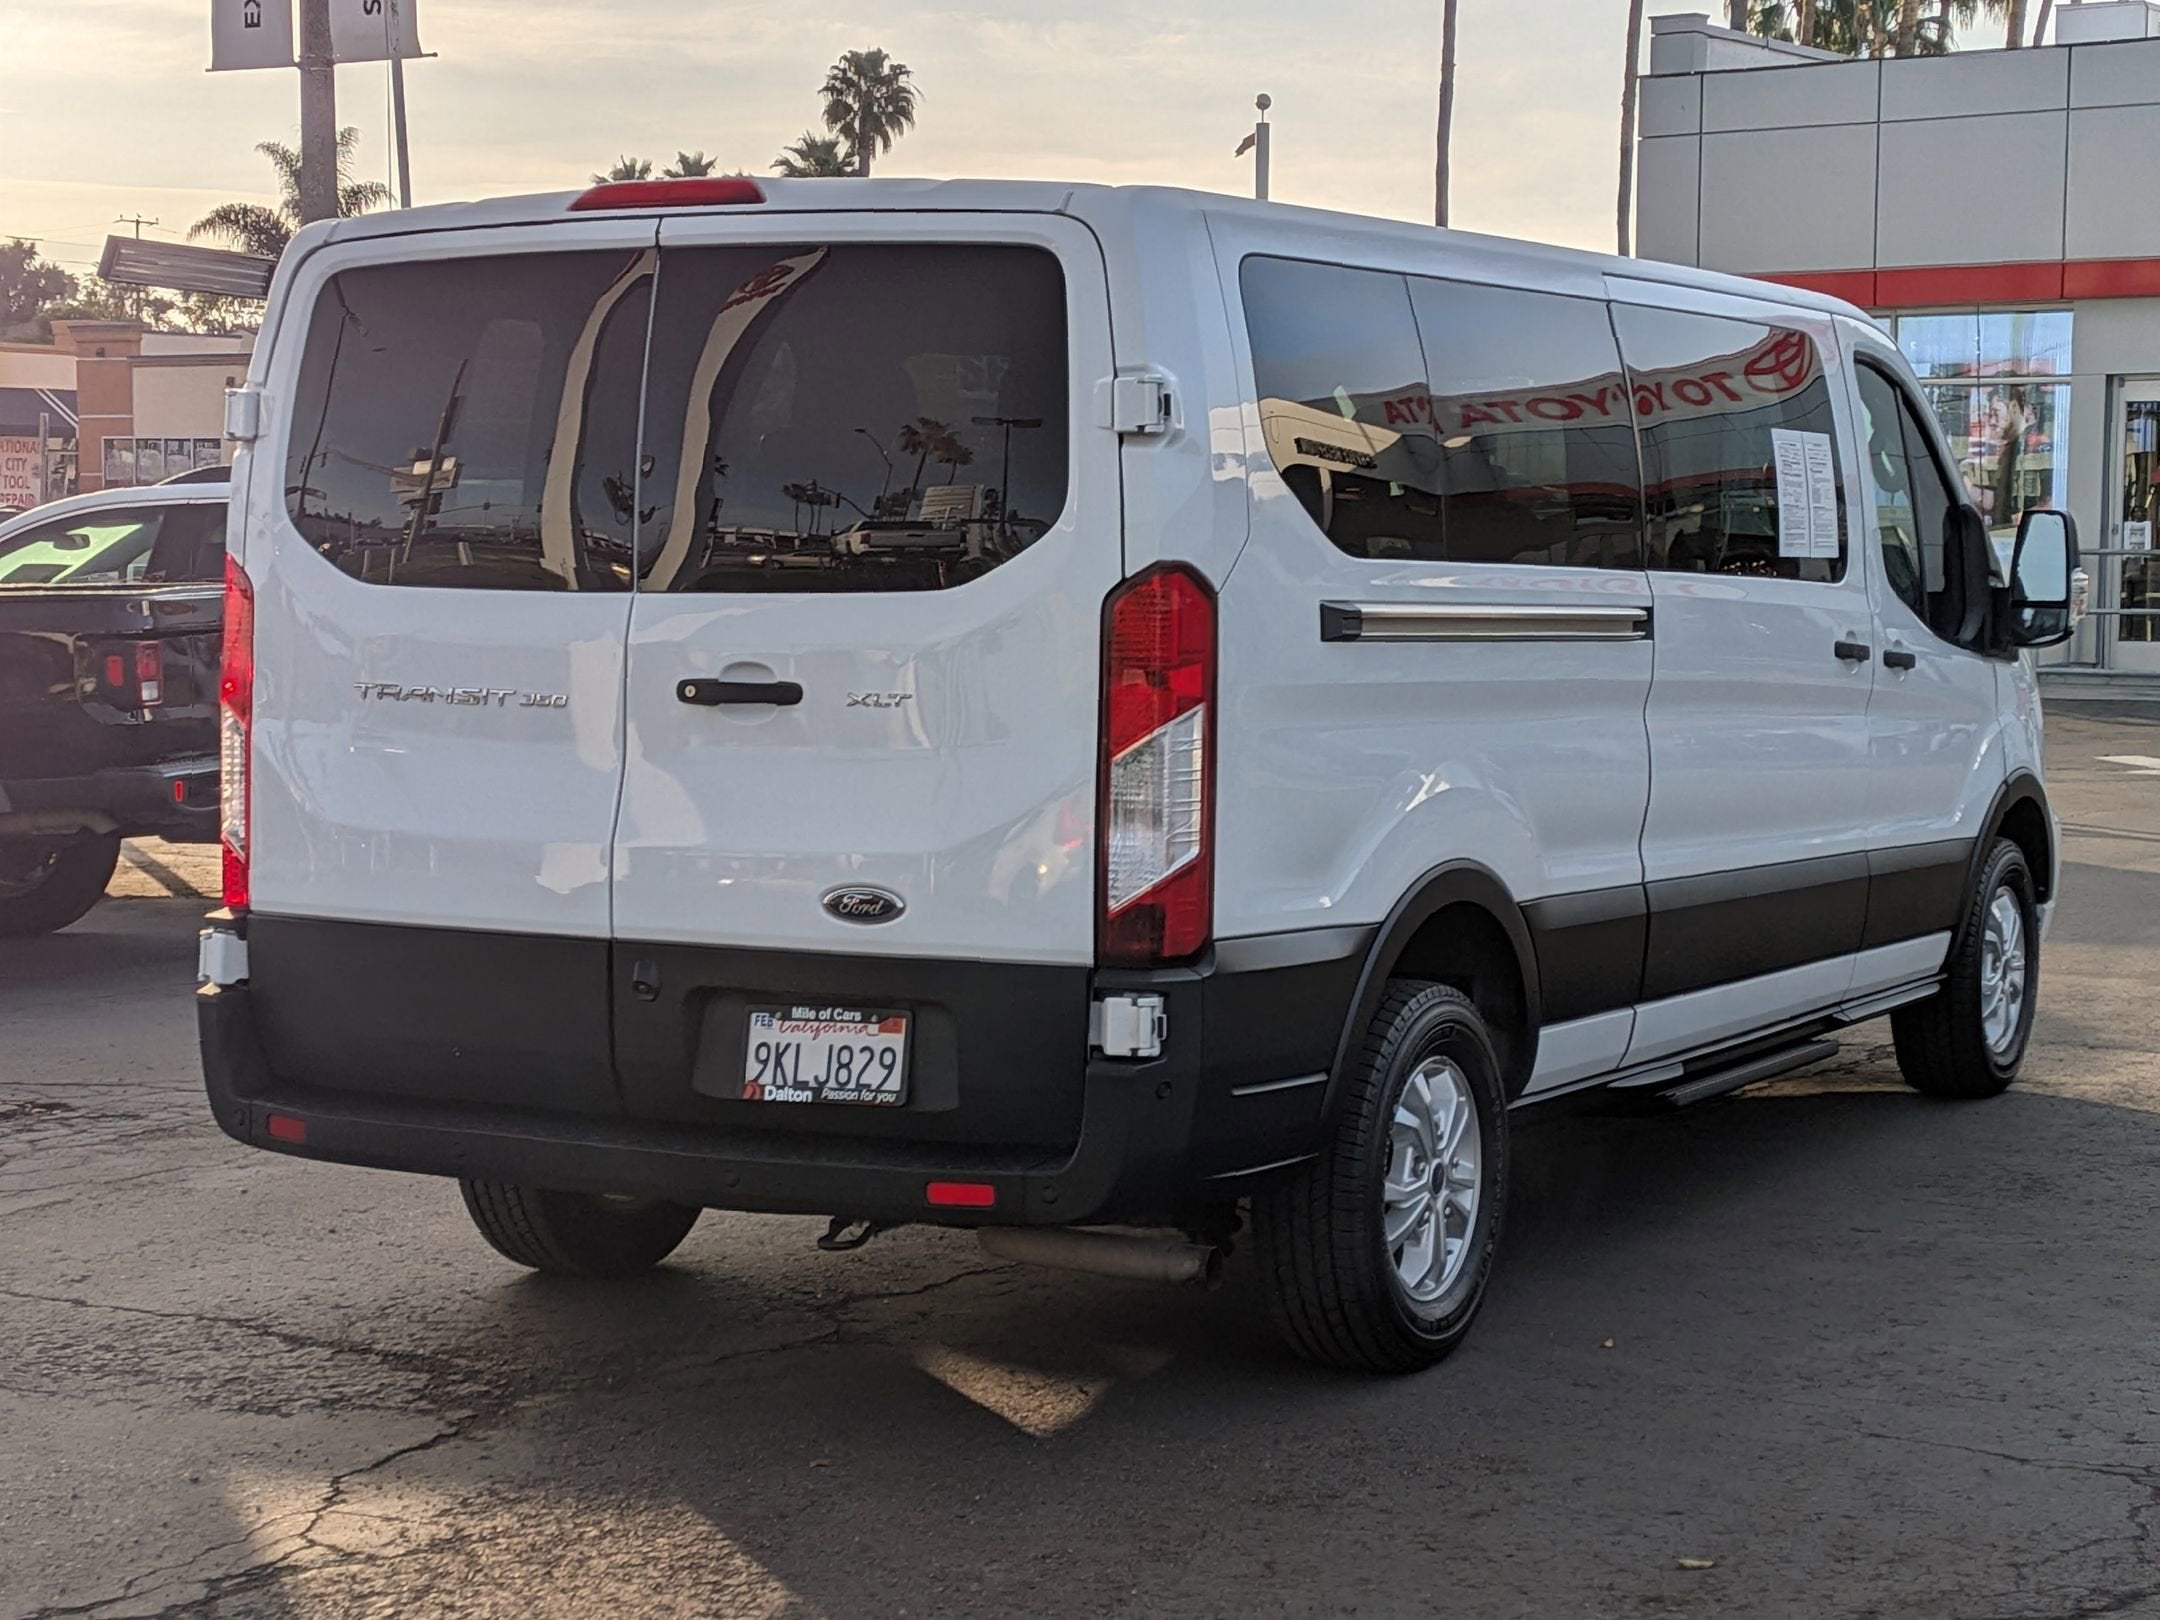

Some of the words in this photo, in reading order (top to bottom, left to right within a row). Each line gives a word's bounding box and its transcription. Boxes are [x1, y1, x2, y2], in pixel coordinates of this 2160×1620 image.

[5, 457, 28, 472] CITY
[3, 474, 31, 490] TOOL
[353, 681, 516, 708] TRANSIT
[520, 693, 569, 709] 350
[846, 692, 913, 708] XLT
[839, 893, 885, 915] Ford
[791, 1006, 817, 1020] Mile
[818, 1007, 832, 1020] of
[833, 1008, 863, 1021] Cars
[778, 1020, 880, 1041] California
[754, 1042, 897, 1090] 9KLJ829
[764, 1086, 813, 1103] Dalton
[820, 1087, 859, 1101] Passion
[859, 1089, 875, 1102] for
[875, 1092, 897, 1104] you
